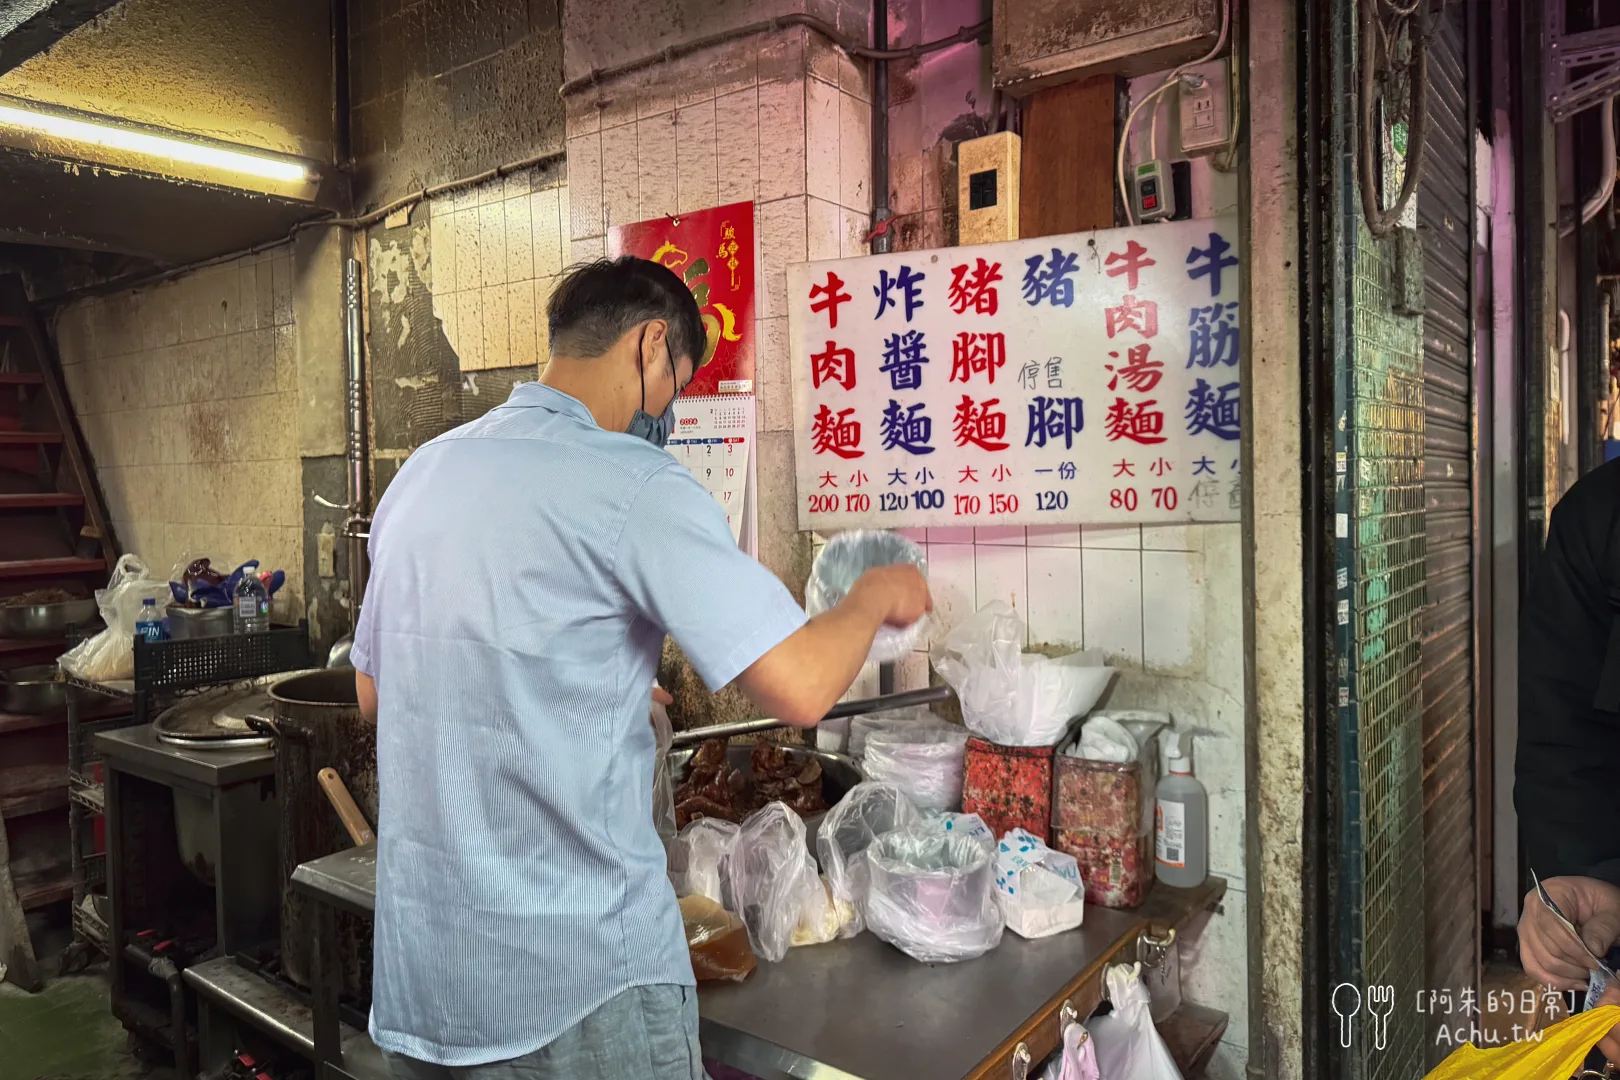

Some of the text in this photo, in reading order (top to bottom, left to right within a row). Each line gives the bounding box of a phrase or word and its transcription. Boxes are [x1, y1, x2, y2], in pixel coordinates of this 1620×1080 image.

[1105, 239, 1169, 446] 牛肉湯麵
[873, 264, 937, 455] 炸醬麵
[947, 256, 1011, 453] 豬腳麵
[808, 270, 866, 460] 牛肉麵
[706, 444, 712, 454] 2
[727, 444, 733, 454] 3
[706, 467, 734, 477] 9 10
[958, 464, 1012, 484] 大 小
[1035, 462, 1077, 480] 一份
[1114, 458, 1172, 478] 大 小
[1192, 456, 1215, 476] 大
[819, 470, 869, 489] 大 小
[888, 467, 935, 486] 大 小
[723, 491, 732, 501] 17
[808, 492, 871, 513] 200 170
[879, 488, 945, 512] 120 100
[953, 491, 1019, 516] 170 150
[1036, 490, 1068, 511] 120
[1109, 486, 1178, 512] 80 70
